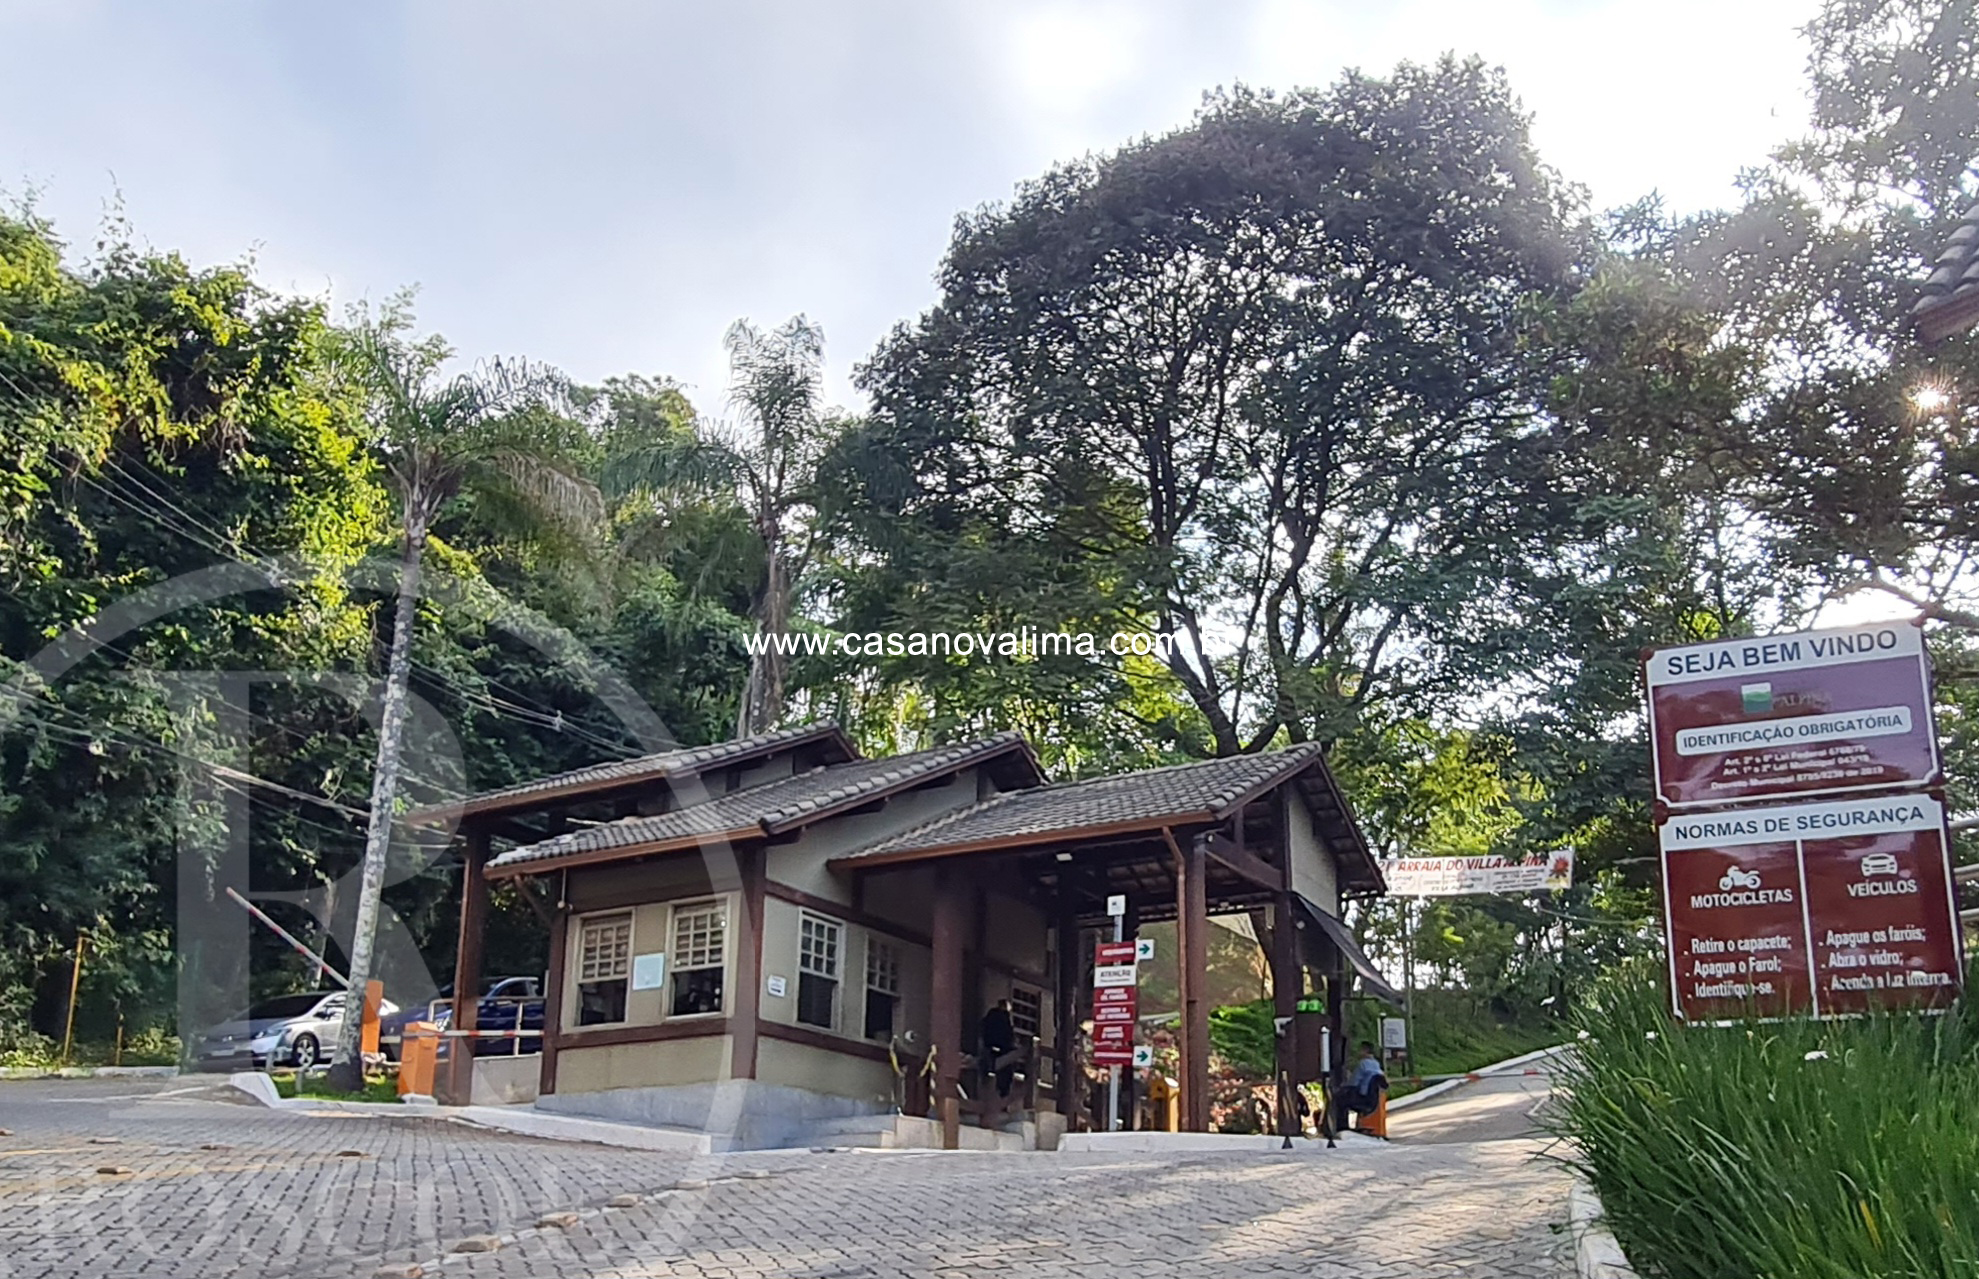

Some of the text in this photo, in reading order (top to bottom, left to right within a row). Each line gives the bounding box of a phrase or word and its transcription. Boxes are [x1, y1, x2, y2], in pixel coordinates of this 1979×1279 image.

[1667, 630, 1897, 676] SEJA BEM VINDO
[1683, 714, 1903, 749] IDENTIFICAÇÃO OBRIGATÓRIA
[1675, 806, 1924, 840] NORMAS DE SEGURANÇA
[1446, 859, 1464, 871] DO
[1466, 857, 1503, 870] VILLA
[1847, 878, 1917, 897] VEÍCULOS
[1691, 889, 1793, 908] MOTOCICLETAS
[1691, 937, 1725, 954] Retire
[1727, 940, 1735, 952] o
[1826, 929, 1870, 948] Apague
[1872, 930, 1887, 942] os
[1693, 960, 1736, 978] Apague
[1738, 961, 1747, 973] o
[1828, 951, 1858, 968] Abra
[1858, 954, 1866, 967] o
[1831, 972, 1874, 990] Acenda
[1876, 974, 1884, 988] a
